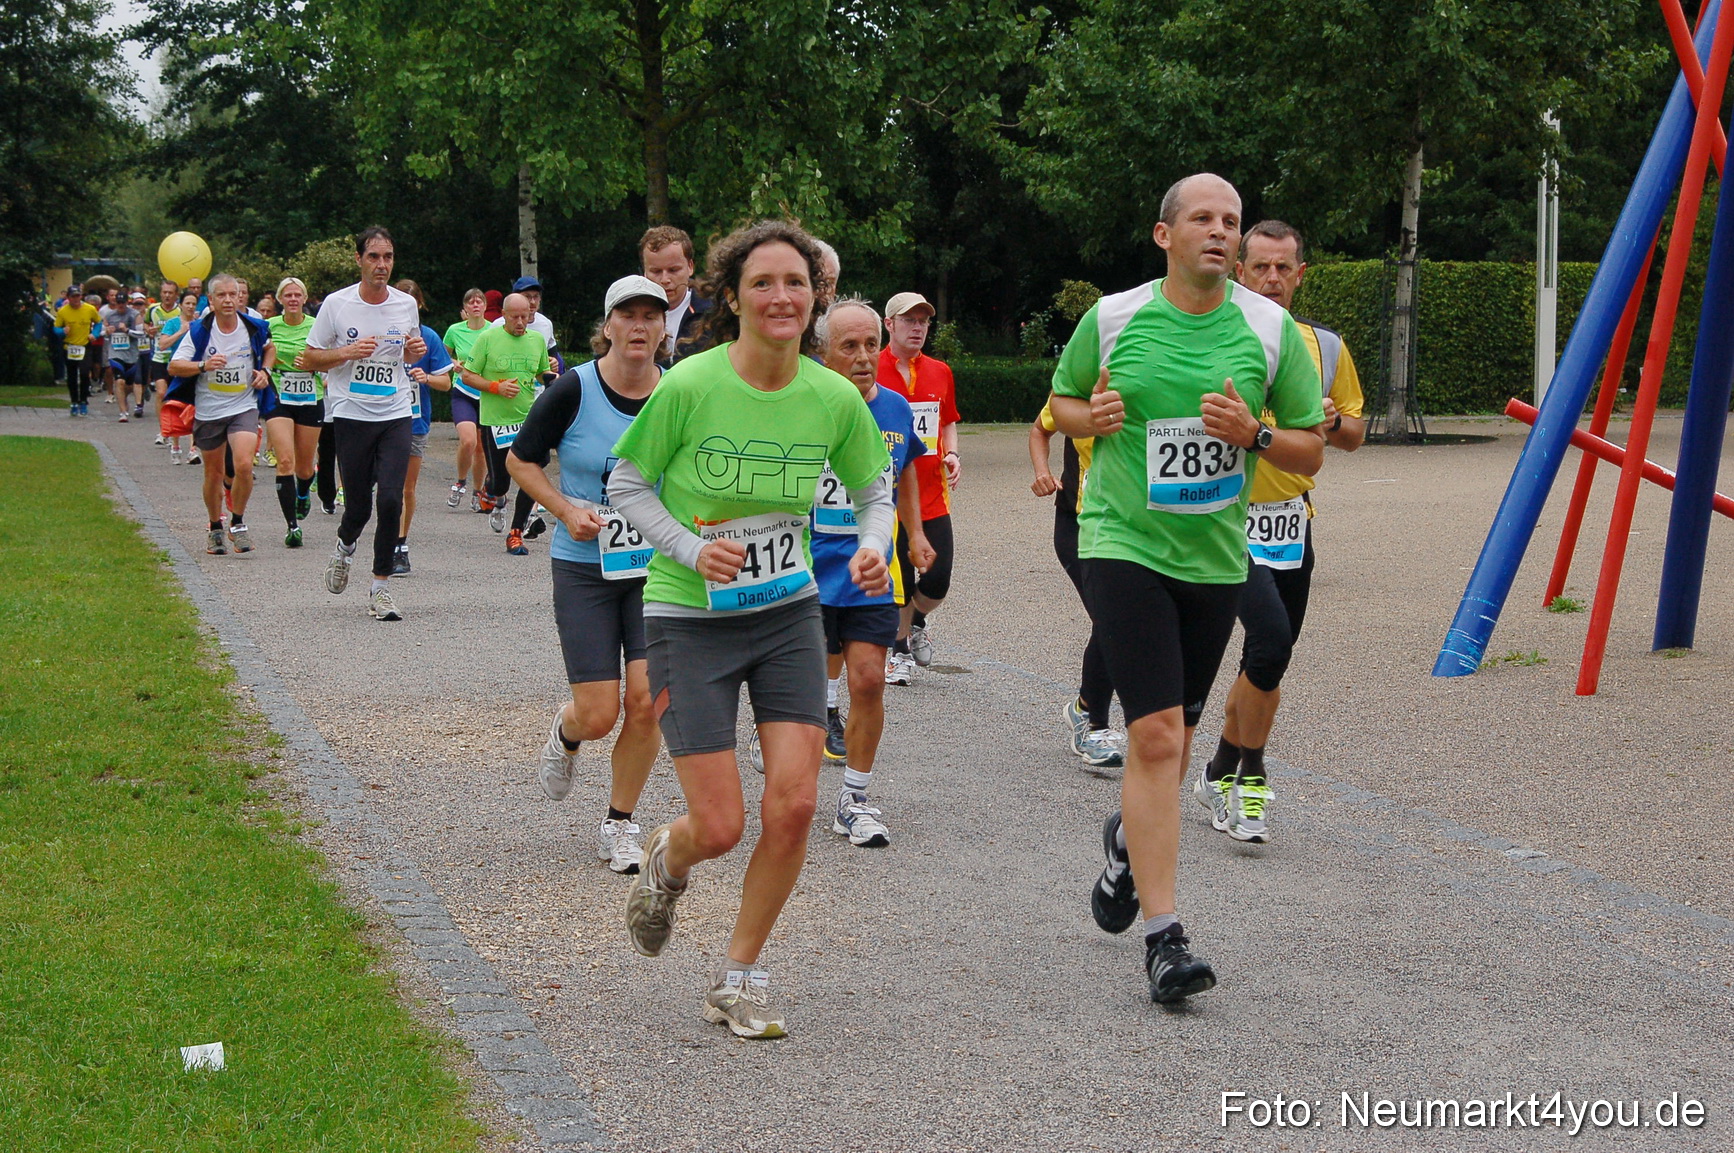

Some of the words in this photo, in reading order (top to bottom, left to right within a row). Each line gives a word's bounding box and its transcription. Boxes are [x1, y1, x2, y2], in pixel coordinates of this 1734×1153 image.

[215, 371, 240, 384] 534
[355, 366, 393, 384] 3063
[284, 380, 313, 393] 2103
[496, 424, 521, 435] 210
[1149, 428, 1185, 437] PARTL
[1187, 428, 1208, 436] Neu
[881, 431, 904, 445] KTER
[695, 436, 828, 498] OPF
[1159, 442, 1240, 478] 2833
[1180, 485, 1221, 501] Robert
[598, 507, 616, 516] PAR
[1262, 502, 1297, 511] Neumarkt
[843, 512, 857, 524] Ge
[608, 519, 643, 548] 25
[703, 529, 741, 541] PARTL
[743, 520, 787, 537] Neumarkt
[1245, 514, 1300, 542] 2908
[630, 553, 653, 566] Silv
[732, 532, 797, 581] 412
[737, 583, 788, 607] Daniela
